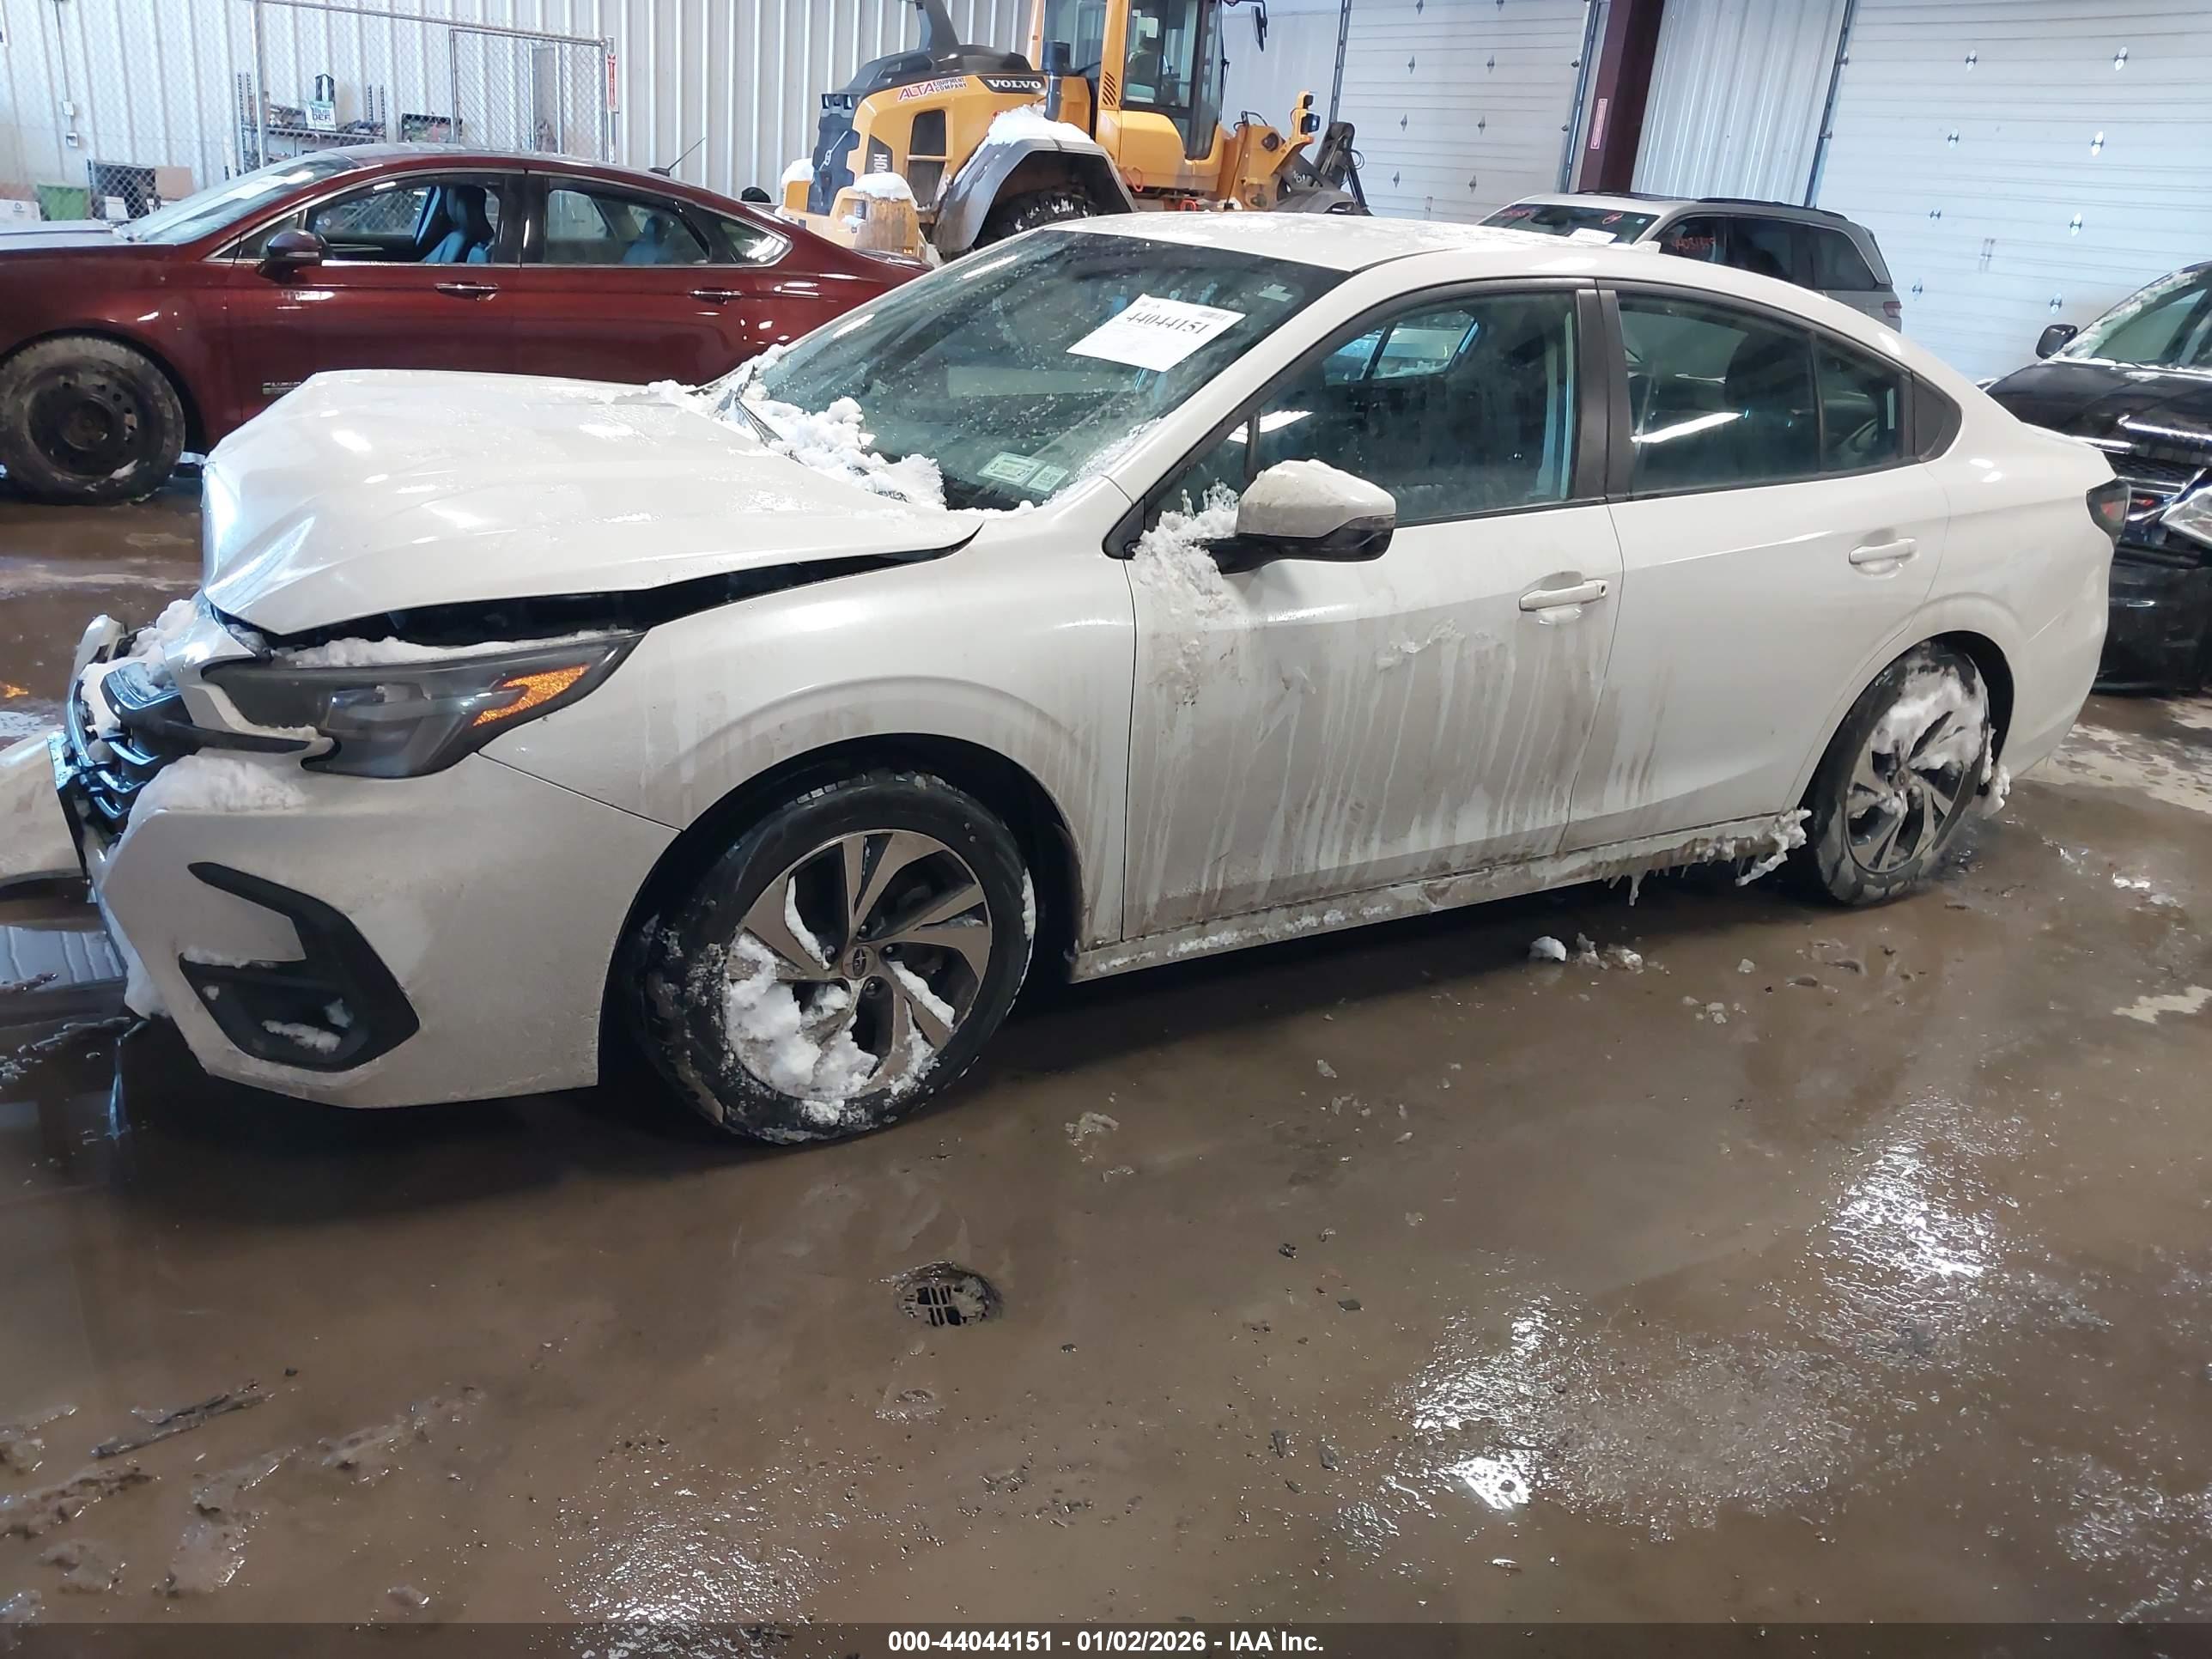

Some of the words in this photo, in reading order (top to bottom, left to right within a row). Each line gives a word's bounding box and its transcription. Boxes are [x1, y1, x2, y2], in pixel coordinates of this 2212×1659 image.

[933, 77, 965, 87] EQUIPMENT
[935, 82, 967, 92] COMPANY
[988, 79, 1042, 89] VOLVO
[899, 82, 935, 100] ALTA
[1127, 312, 1210, 334] 44044151
